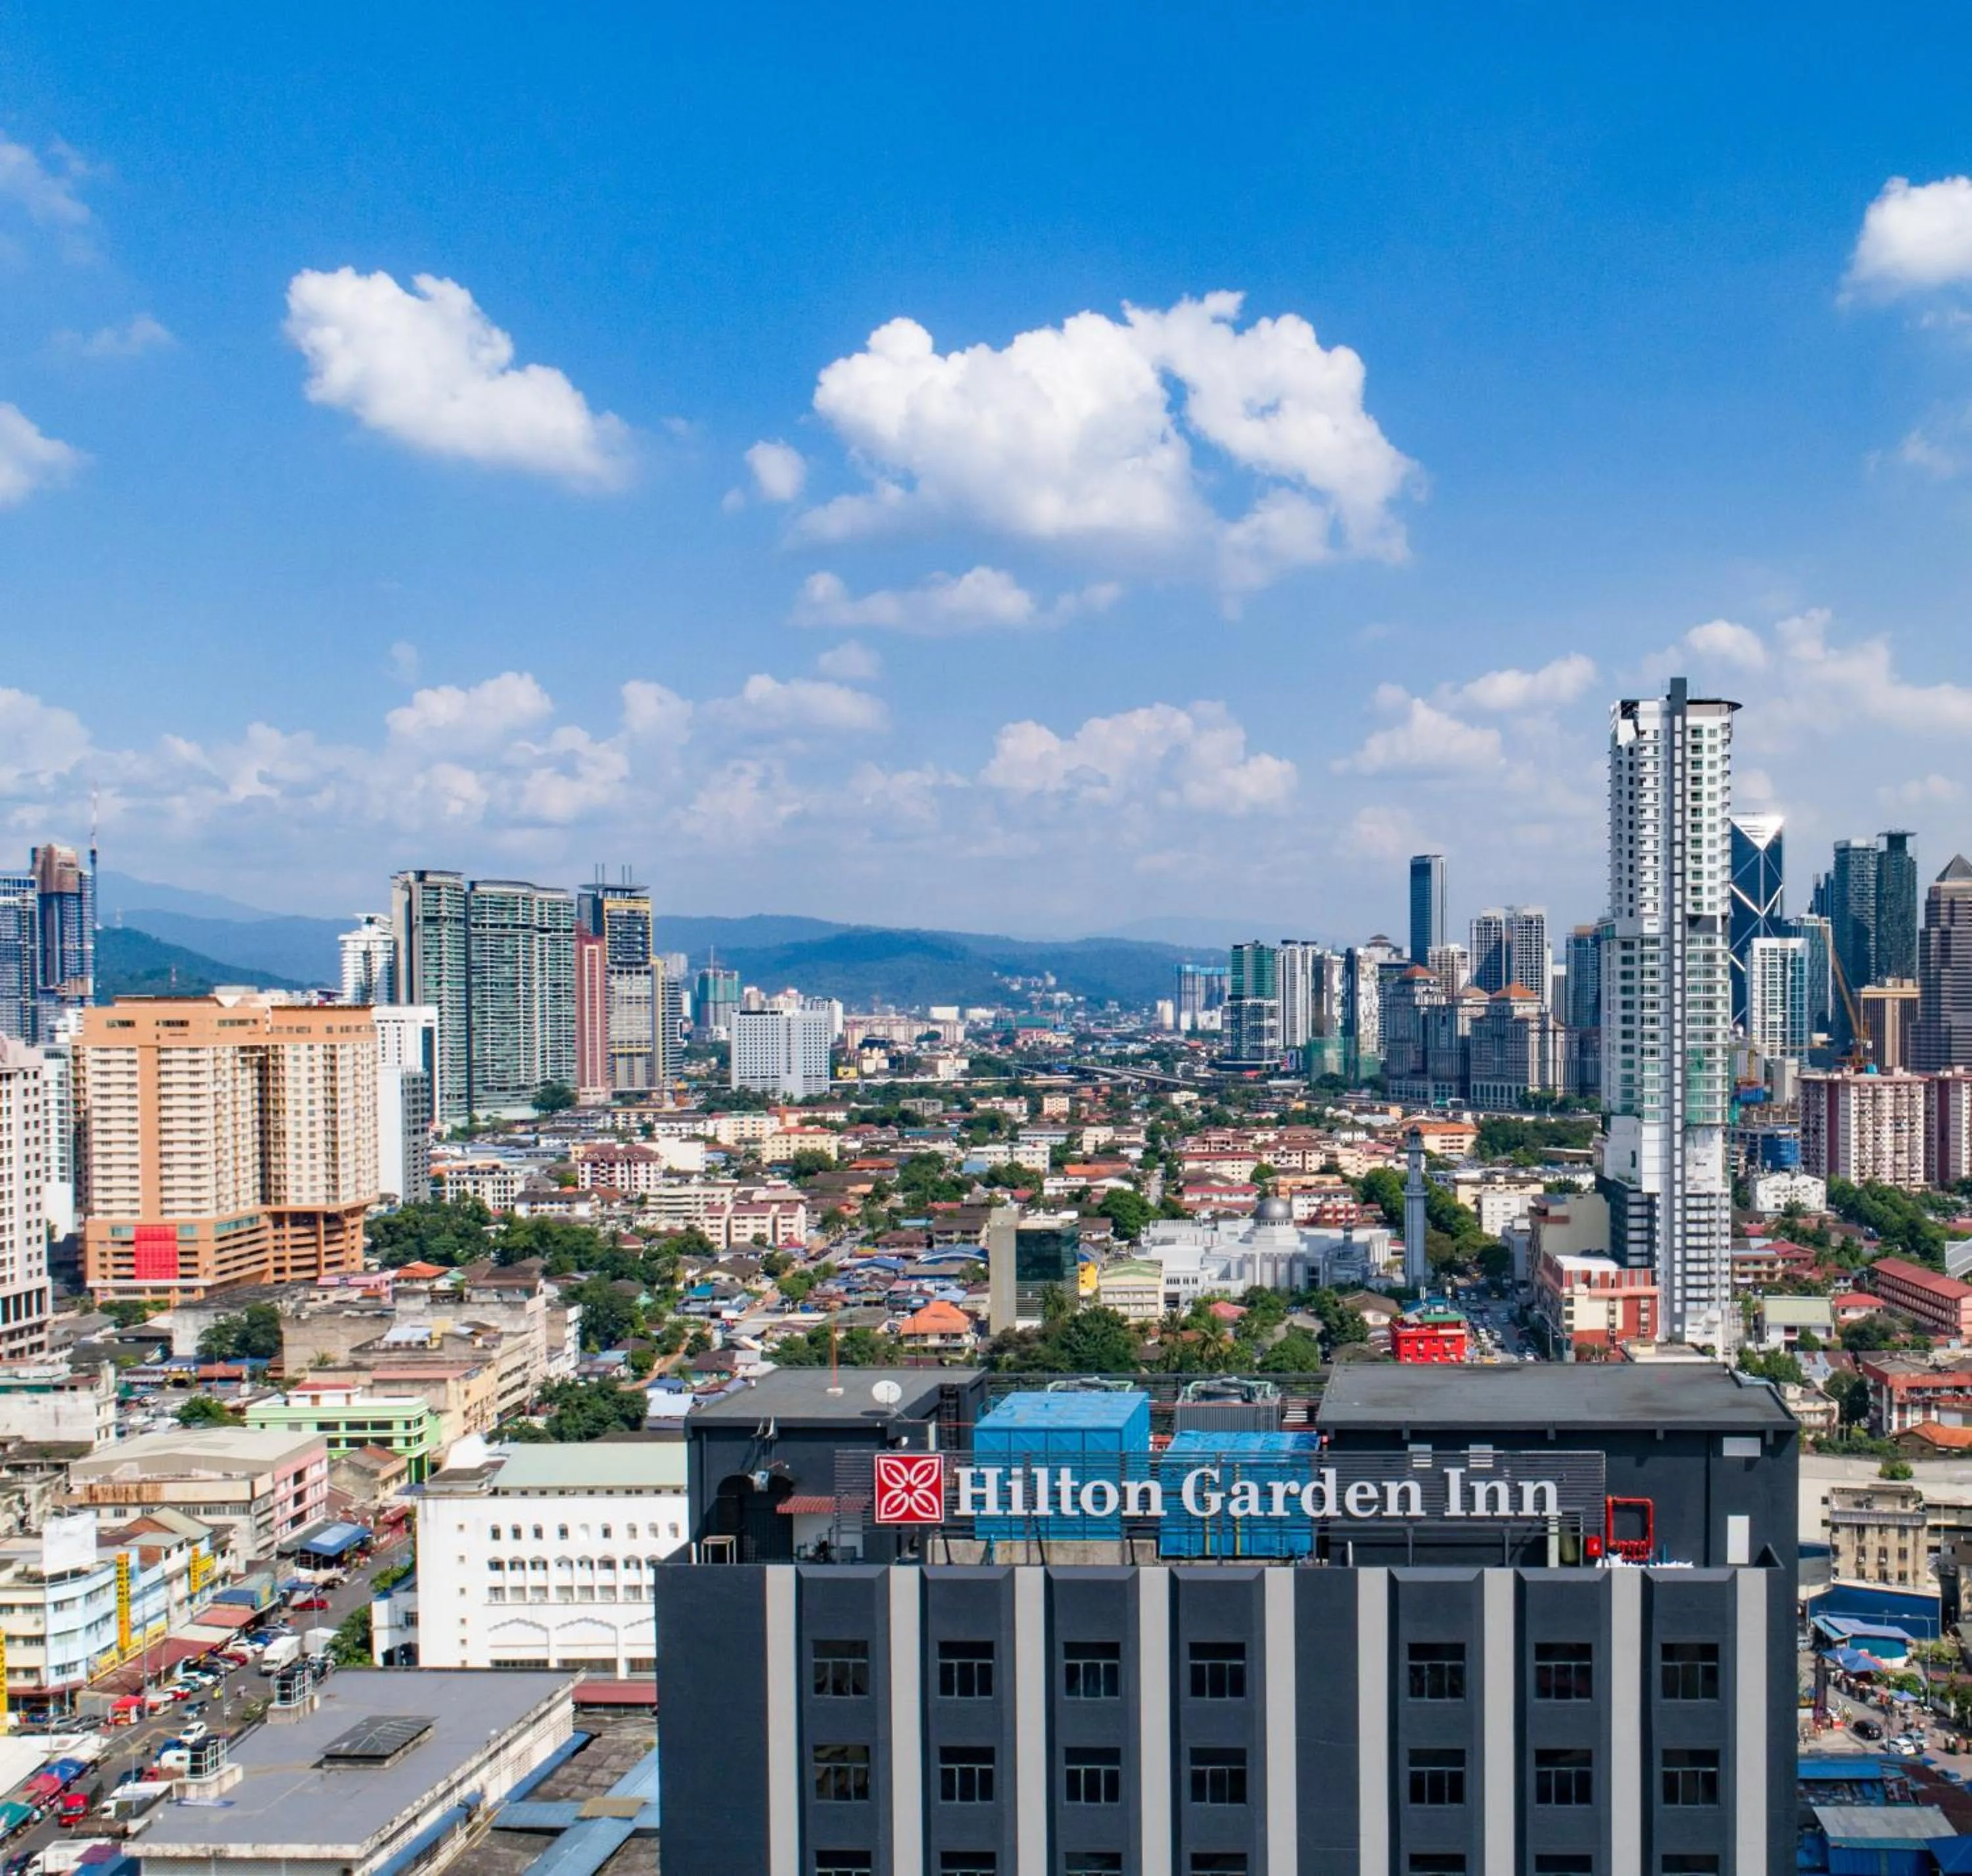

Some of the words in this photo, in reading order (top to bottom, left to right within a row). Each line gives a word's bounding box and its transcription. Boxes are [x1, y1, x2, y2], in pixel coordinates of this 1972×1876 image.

[954, 1467, 1167, 1516] Hilton
[1181, 1467, 1427, 1517] Garden
[1443, 1467, 1562, 1516] Inn
